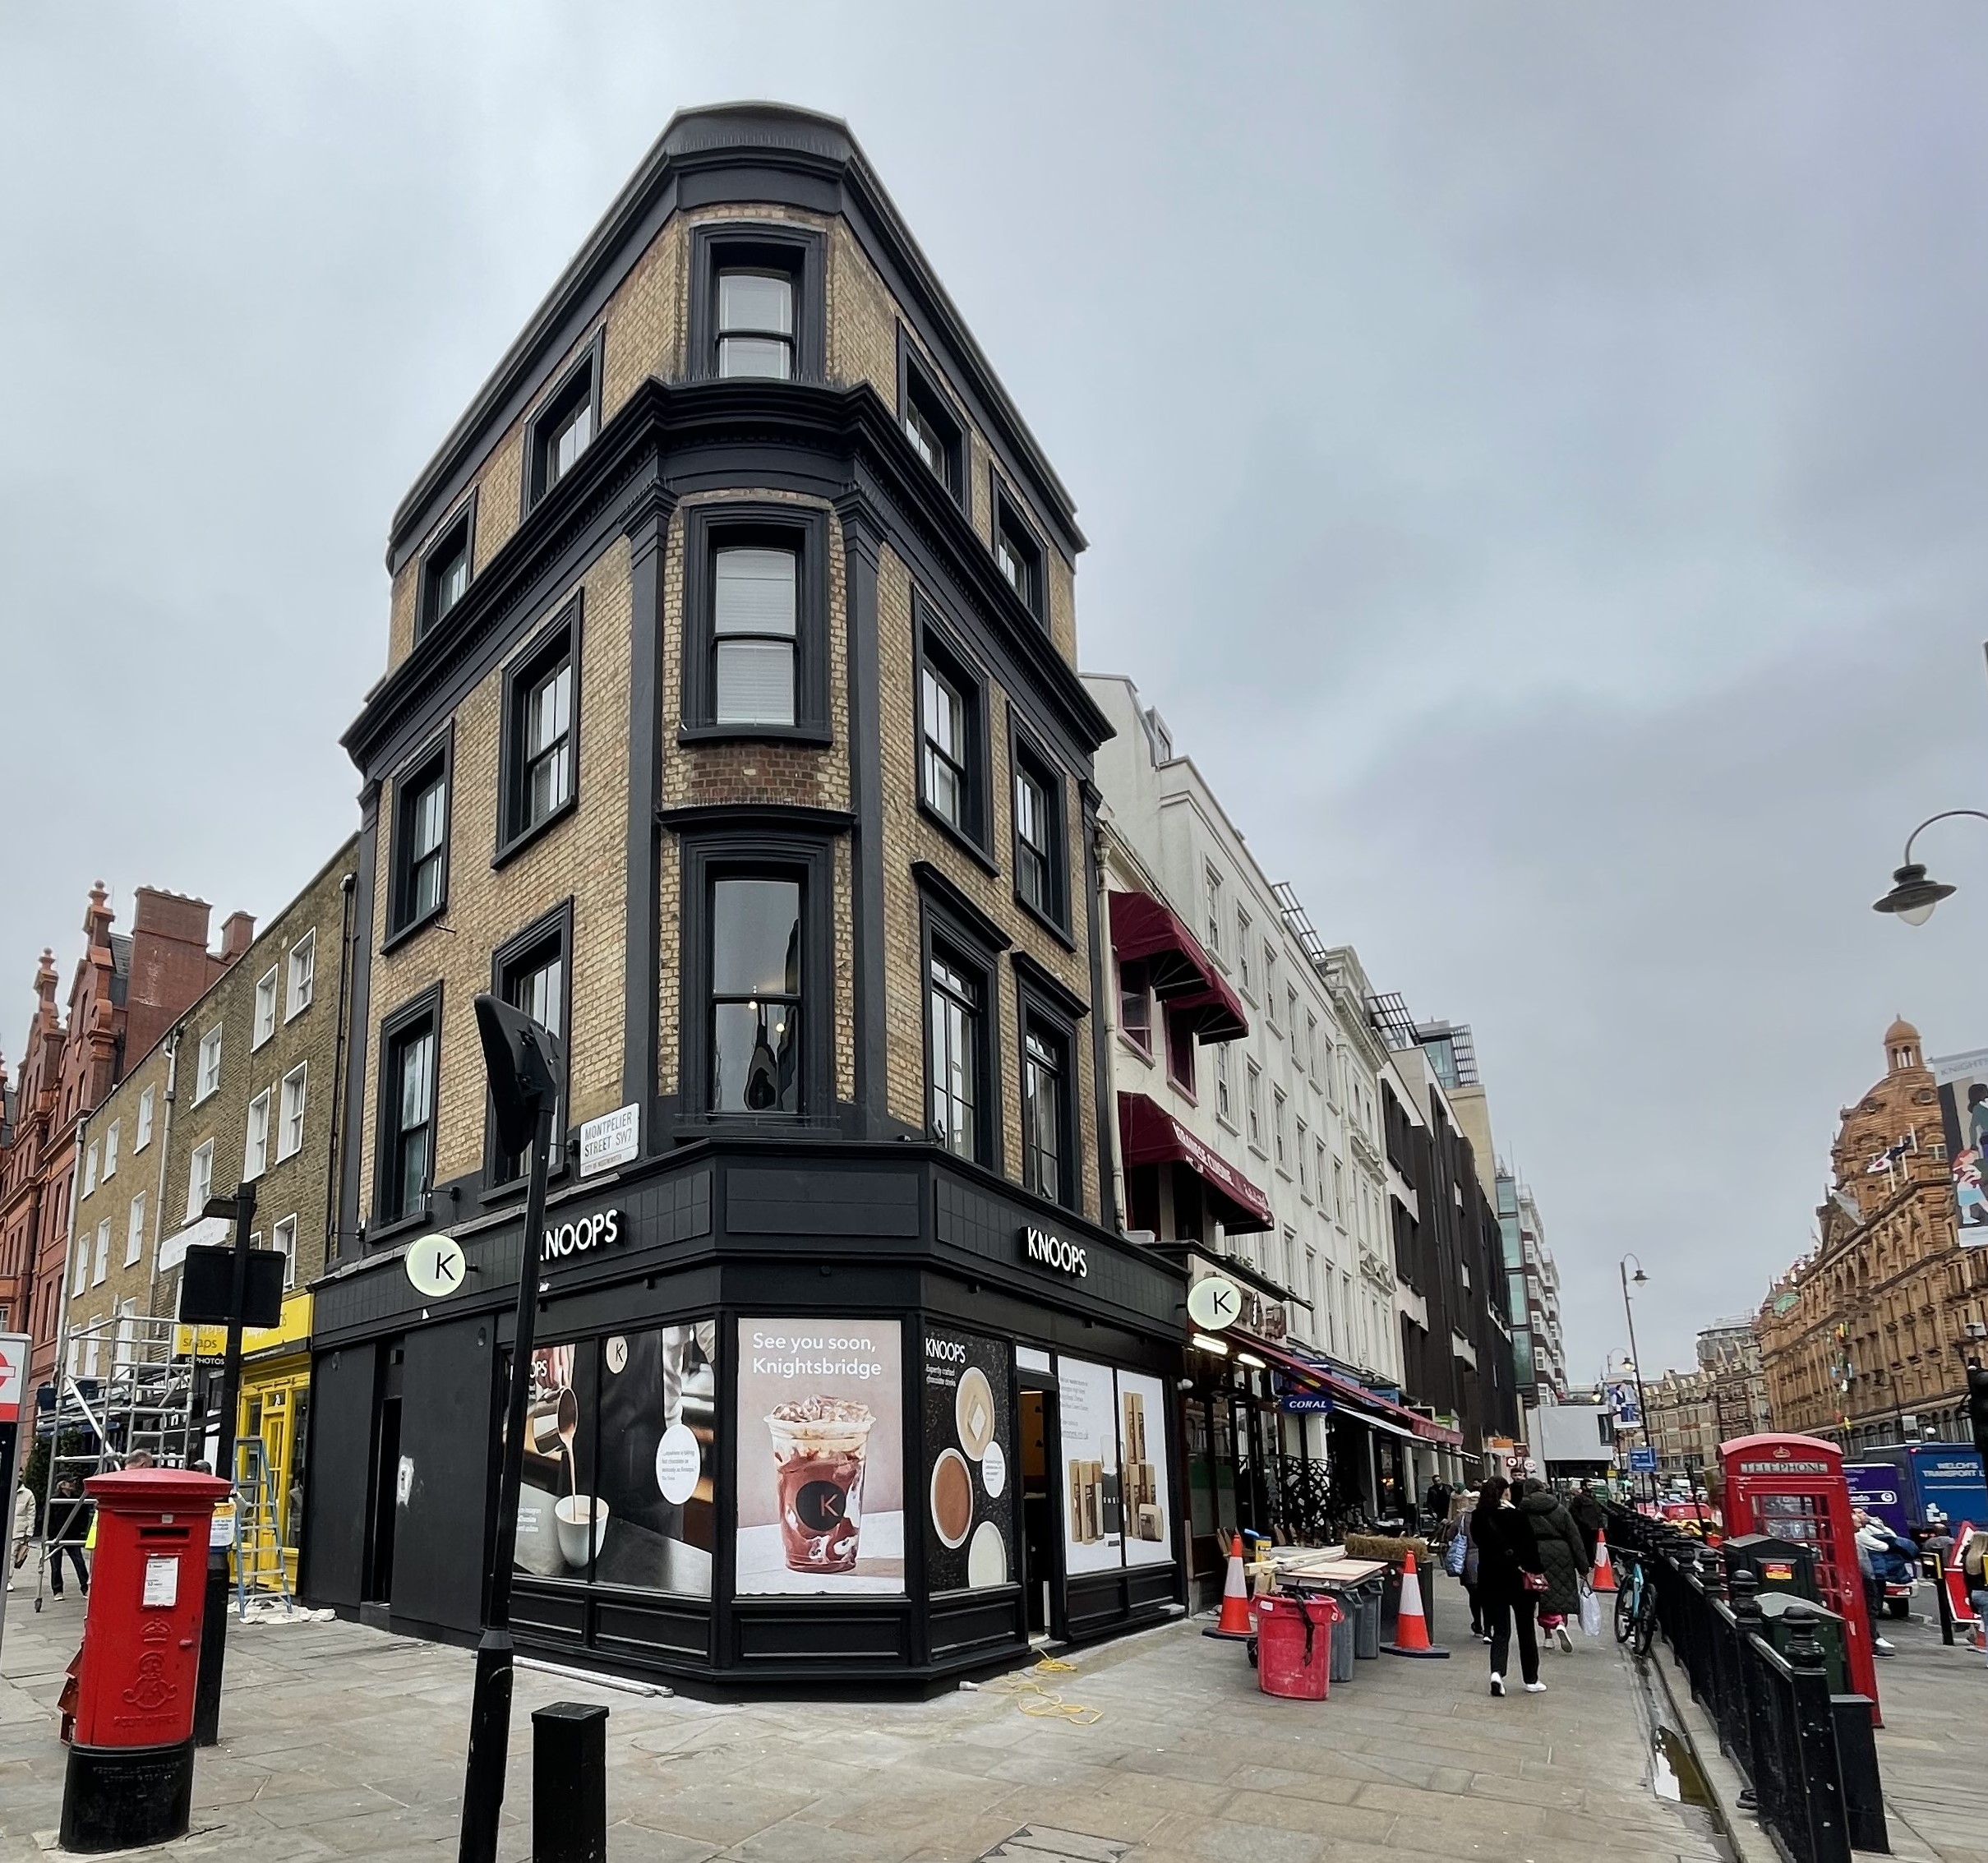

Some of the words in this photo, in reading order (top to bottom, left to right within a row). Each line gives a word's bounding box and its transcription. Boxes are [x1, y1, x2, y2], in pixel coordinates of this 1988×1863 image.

[584, 1112, 632, 1141] MONTPELIER
[584, 1136, 611, 1157] STREET
[616, 1127, 632, 1146] SW7
[540, 1209, 618, 1261] NOOPS
[1027, 1226, 1088, 1278] KNOOPS
[436, 1252, 457, 1281] K
[1213, 1290, 1234, 1315] K
[615, 1343, 624, 1363] K
[753, 1332, 786, 1349] See
[791, 1337, 823, 1353] you
[828, 1337, 876, 1353] soon,
[925, 1337, 966, 1363] KNOOPS
[753, 1357, 882, 1380] Knightsbridge
[1289, 1400, 1327, 1409] CORAL
[1741, 1463, 1826, 1473] TELEPHONE
[820, 1493, 838, 1517] K
